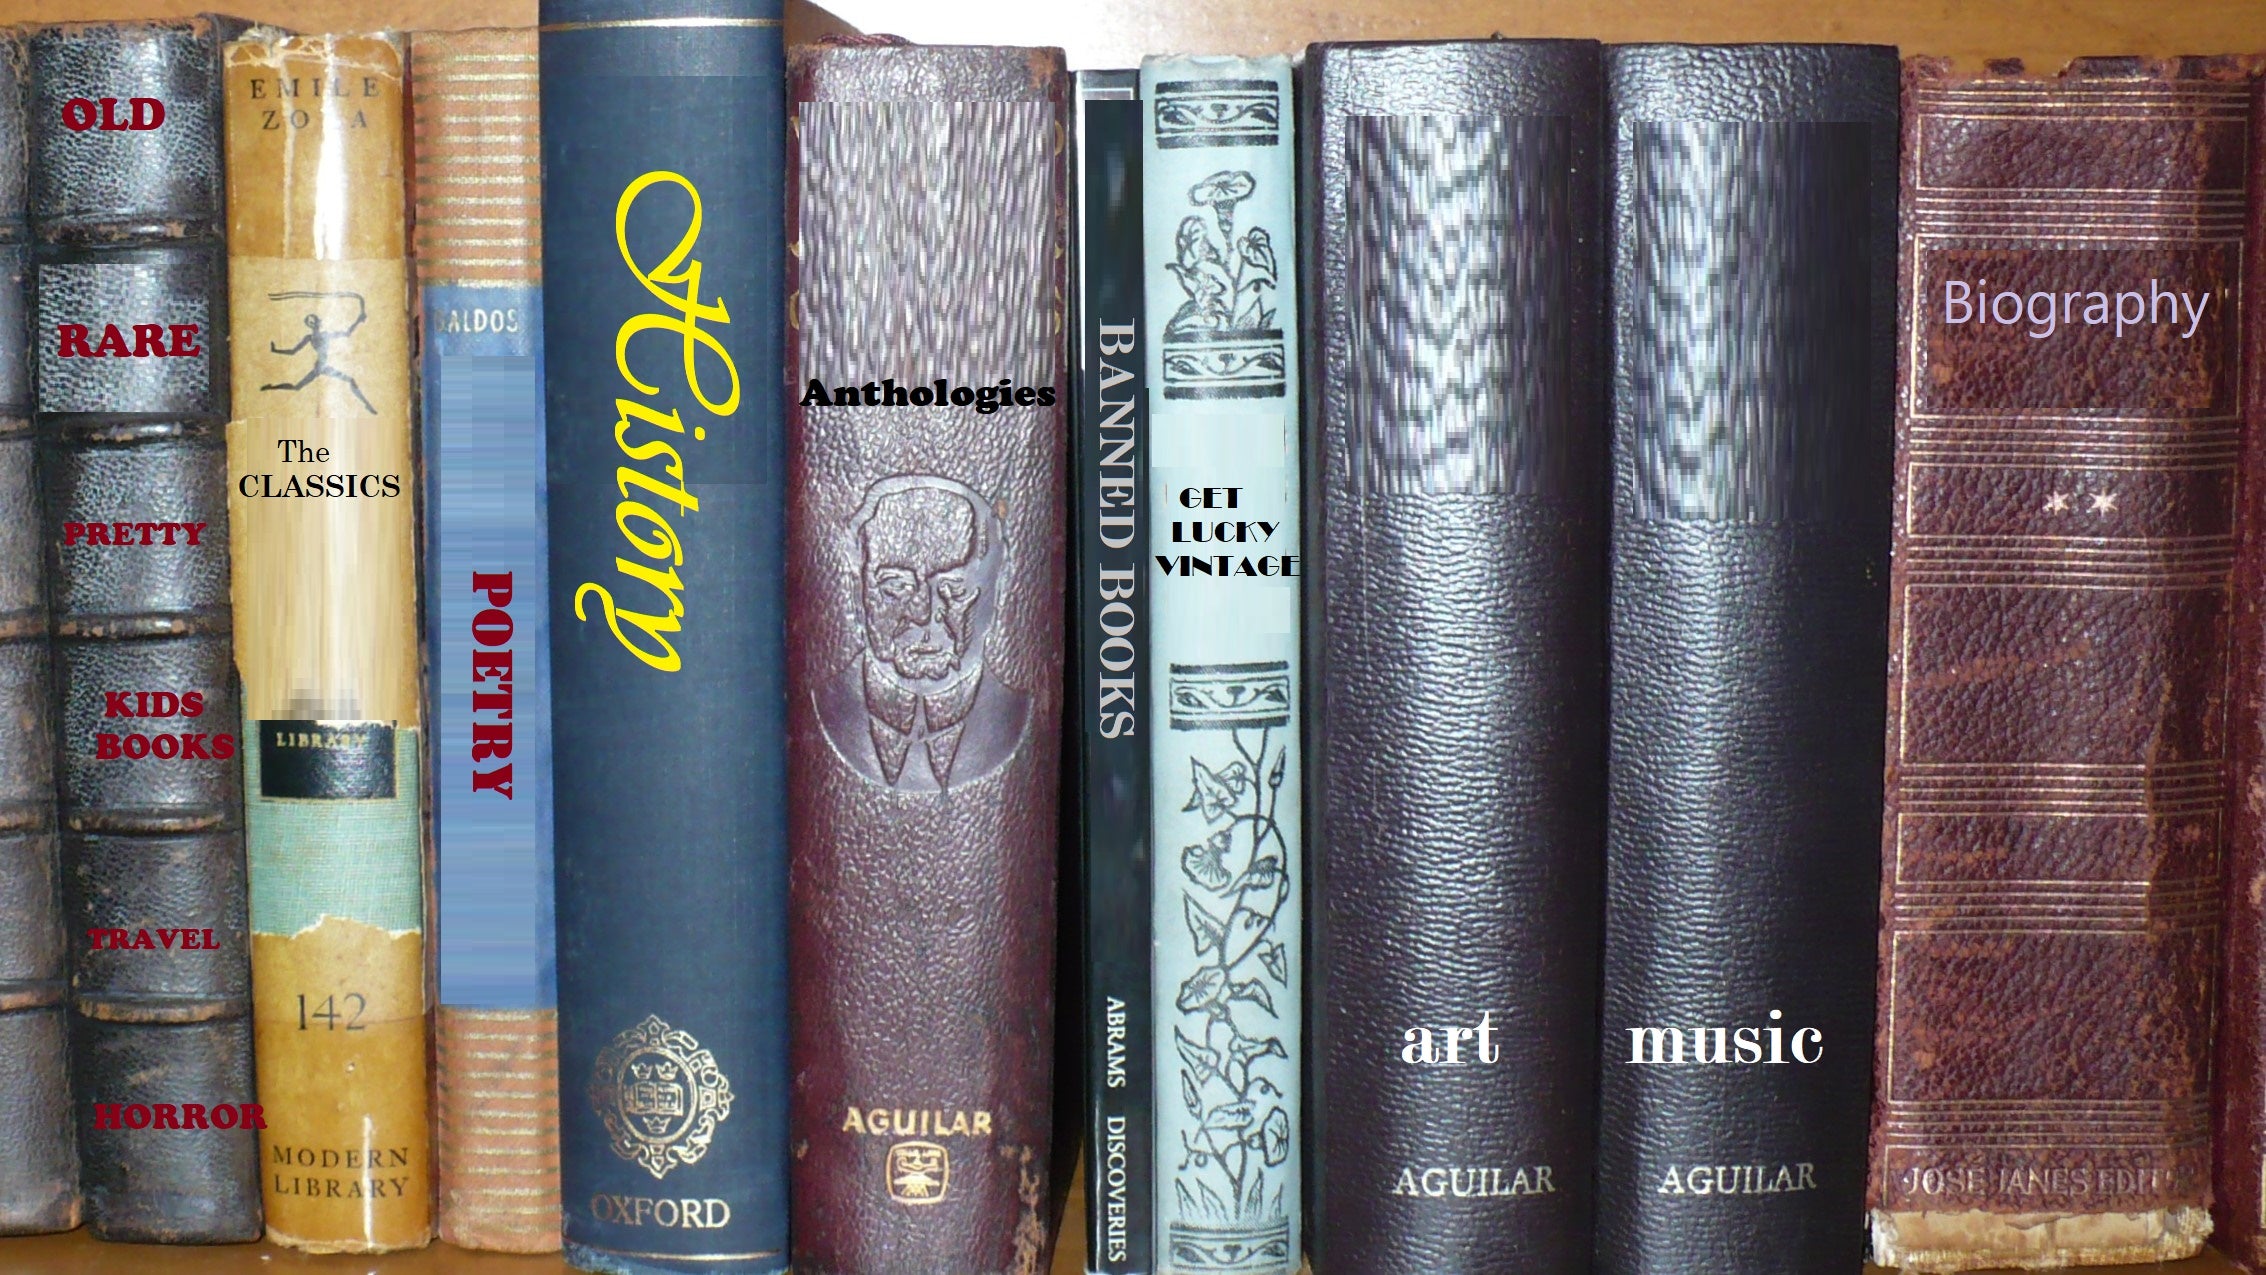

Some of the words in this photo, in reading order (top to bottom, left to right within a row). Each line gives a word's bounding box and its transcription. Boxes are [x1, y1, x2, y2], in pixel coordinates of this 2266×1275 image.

[250, 77, 380, 99] EMILE
[262, 109, 368, 130] ZOA
[276, 732, 367, 748] LIBRARY
[297, 993, 367, 1031] 142
[1106, 996, 1127, 1088] ABRAMS
[842, 1106, 992, 1136] AGUILAR
[272, 1145, 409, 1169] MODERN
[274, 1173, 409, 1198] LIBRARY
[1106, 1116, 1127, 1262] DISCOVERIES
[1392, 1165, 1556, 1197] AGUILAR
[1657, 1162, 1817, 1195] AGUILAR
[592, 1192, 731, 1228] OXFORD
